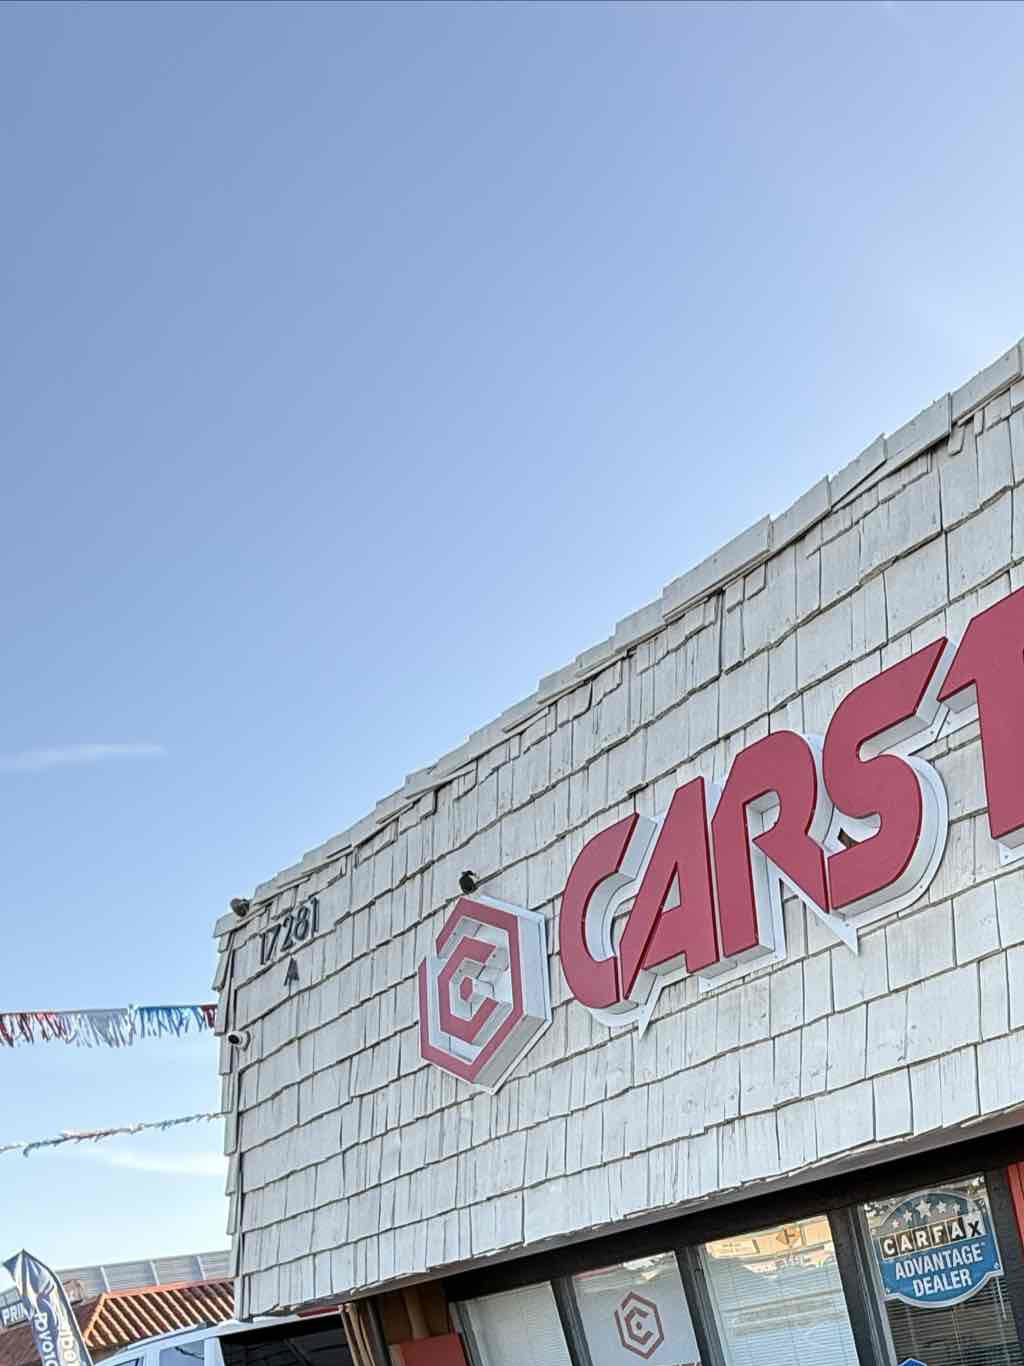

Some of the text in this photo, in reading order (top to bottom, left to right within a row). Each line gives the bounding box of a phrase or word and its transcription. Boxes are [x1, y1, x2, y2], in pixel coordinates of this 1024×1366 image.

[259, 897, 319, 965] 17281
[882, 1217, 983, 1256] CARFAX
[894, 1244, 984, 1281] ADVANTAGE
[912, 1269, 972, 1297] DEALER
